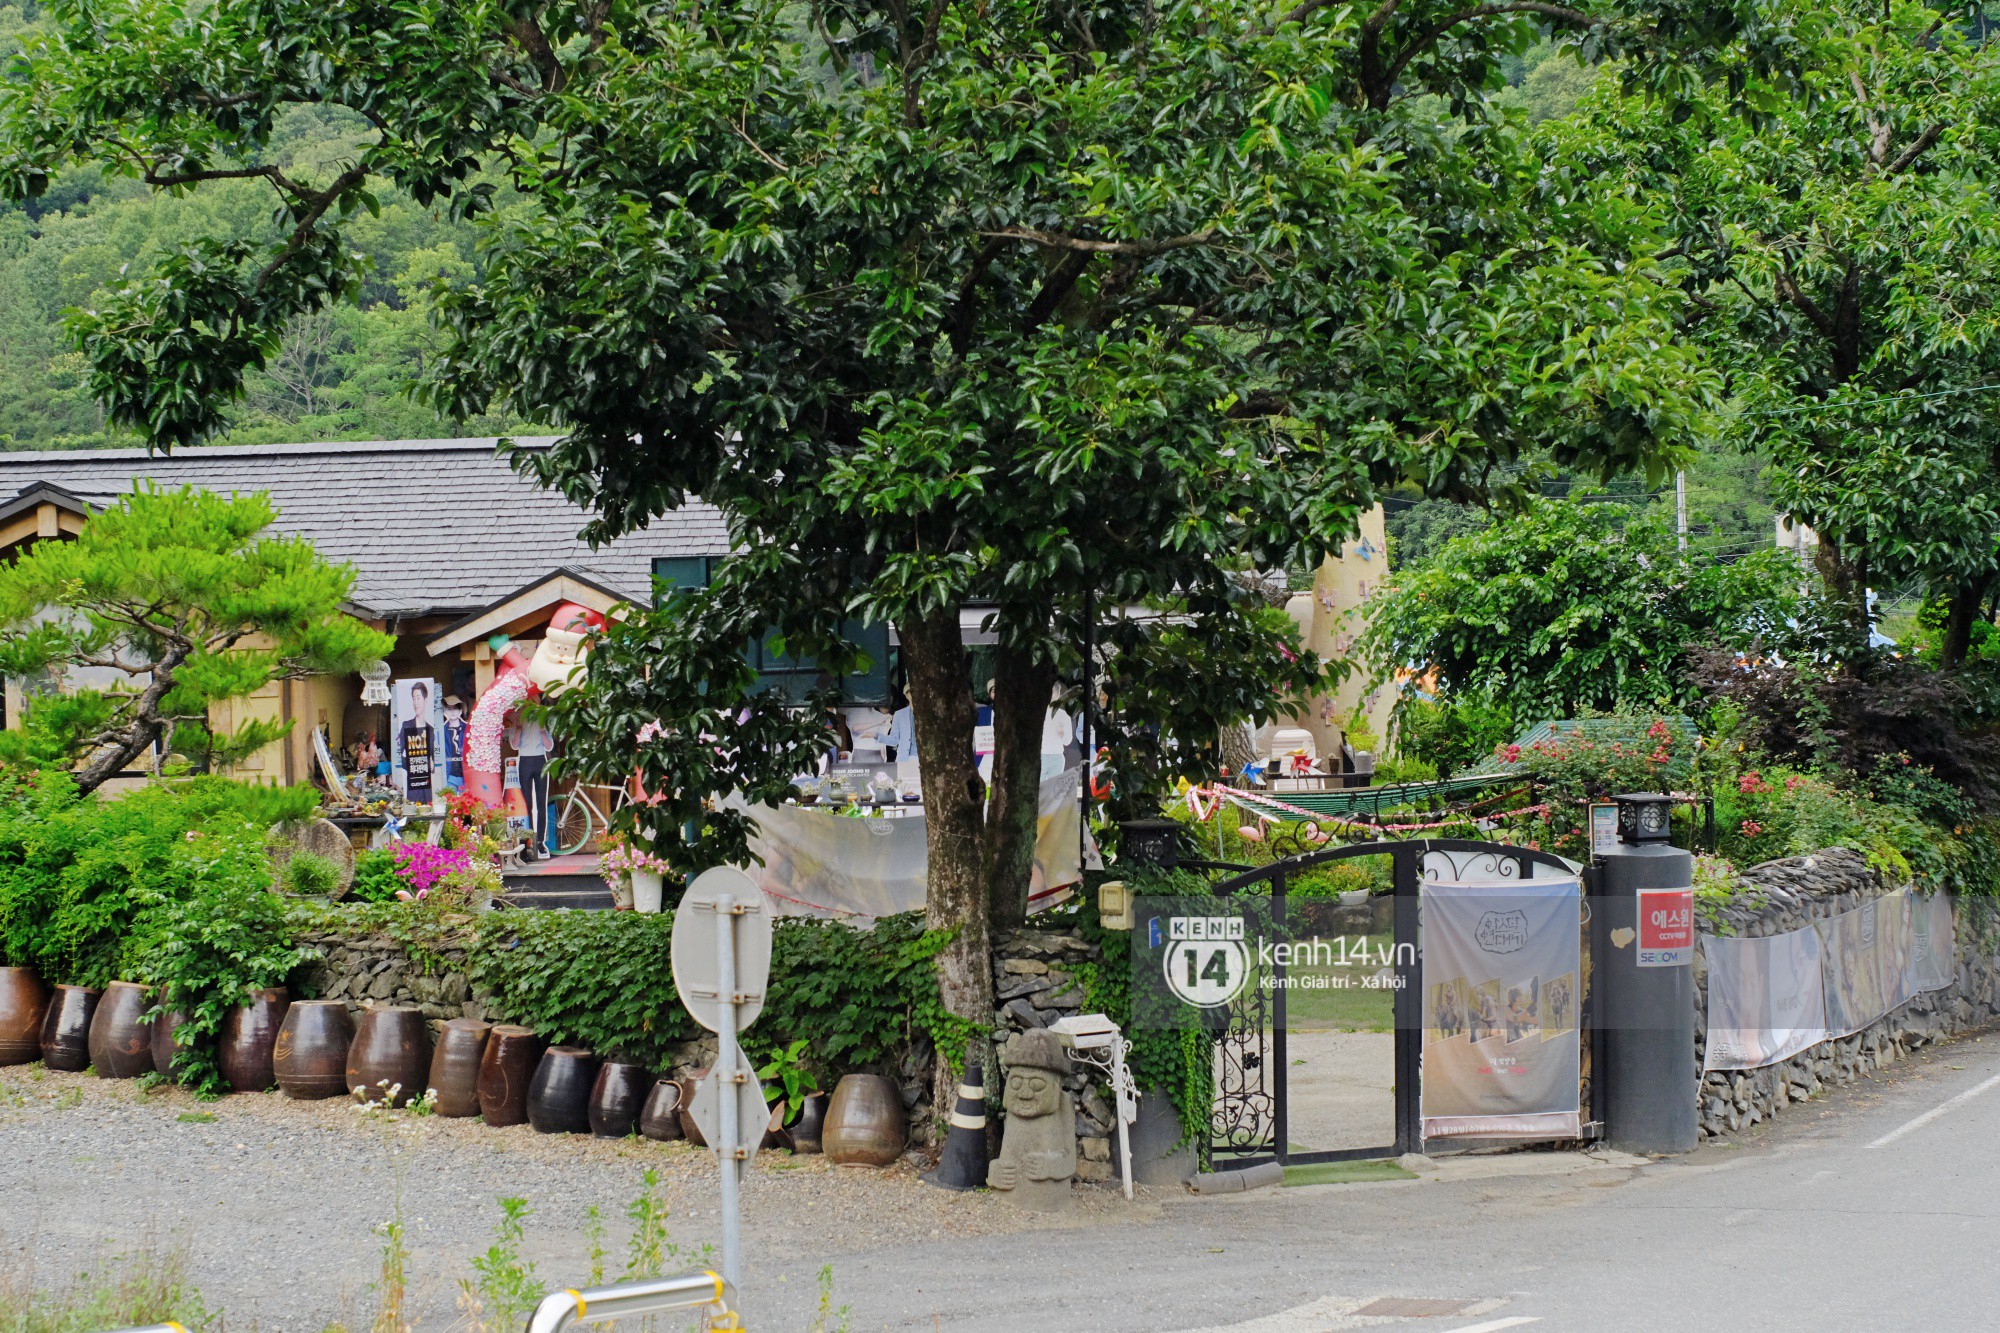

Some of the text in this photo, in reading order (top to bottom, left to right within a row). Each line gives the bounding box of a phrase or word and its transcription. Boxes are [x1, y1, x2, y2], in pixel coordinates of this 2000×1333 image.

[408, 729, 427, 749] NO.1
[1651, 908, 1689, 929] 에스원
[1641, 951, 1678, 963] SECOM
